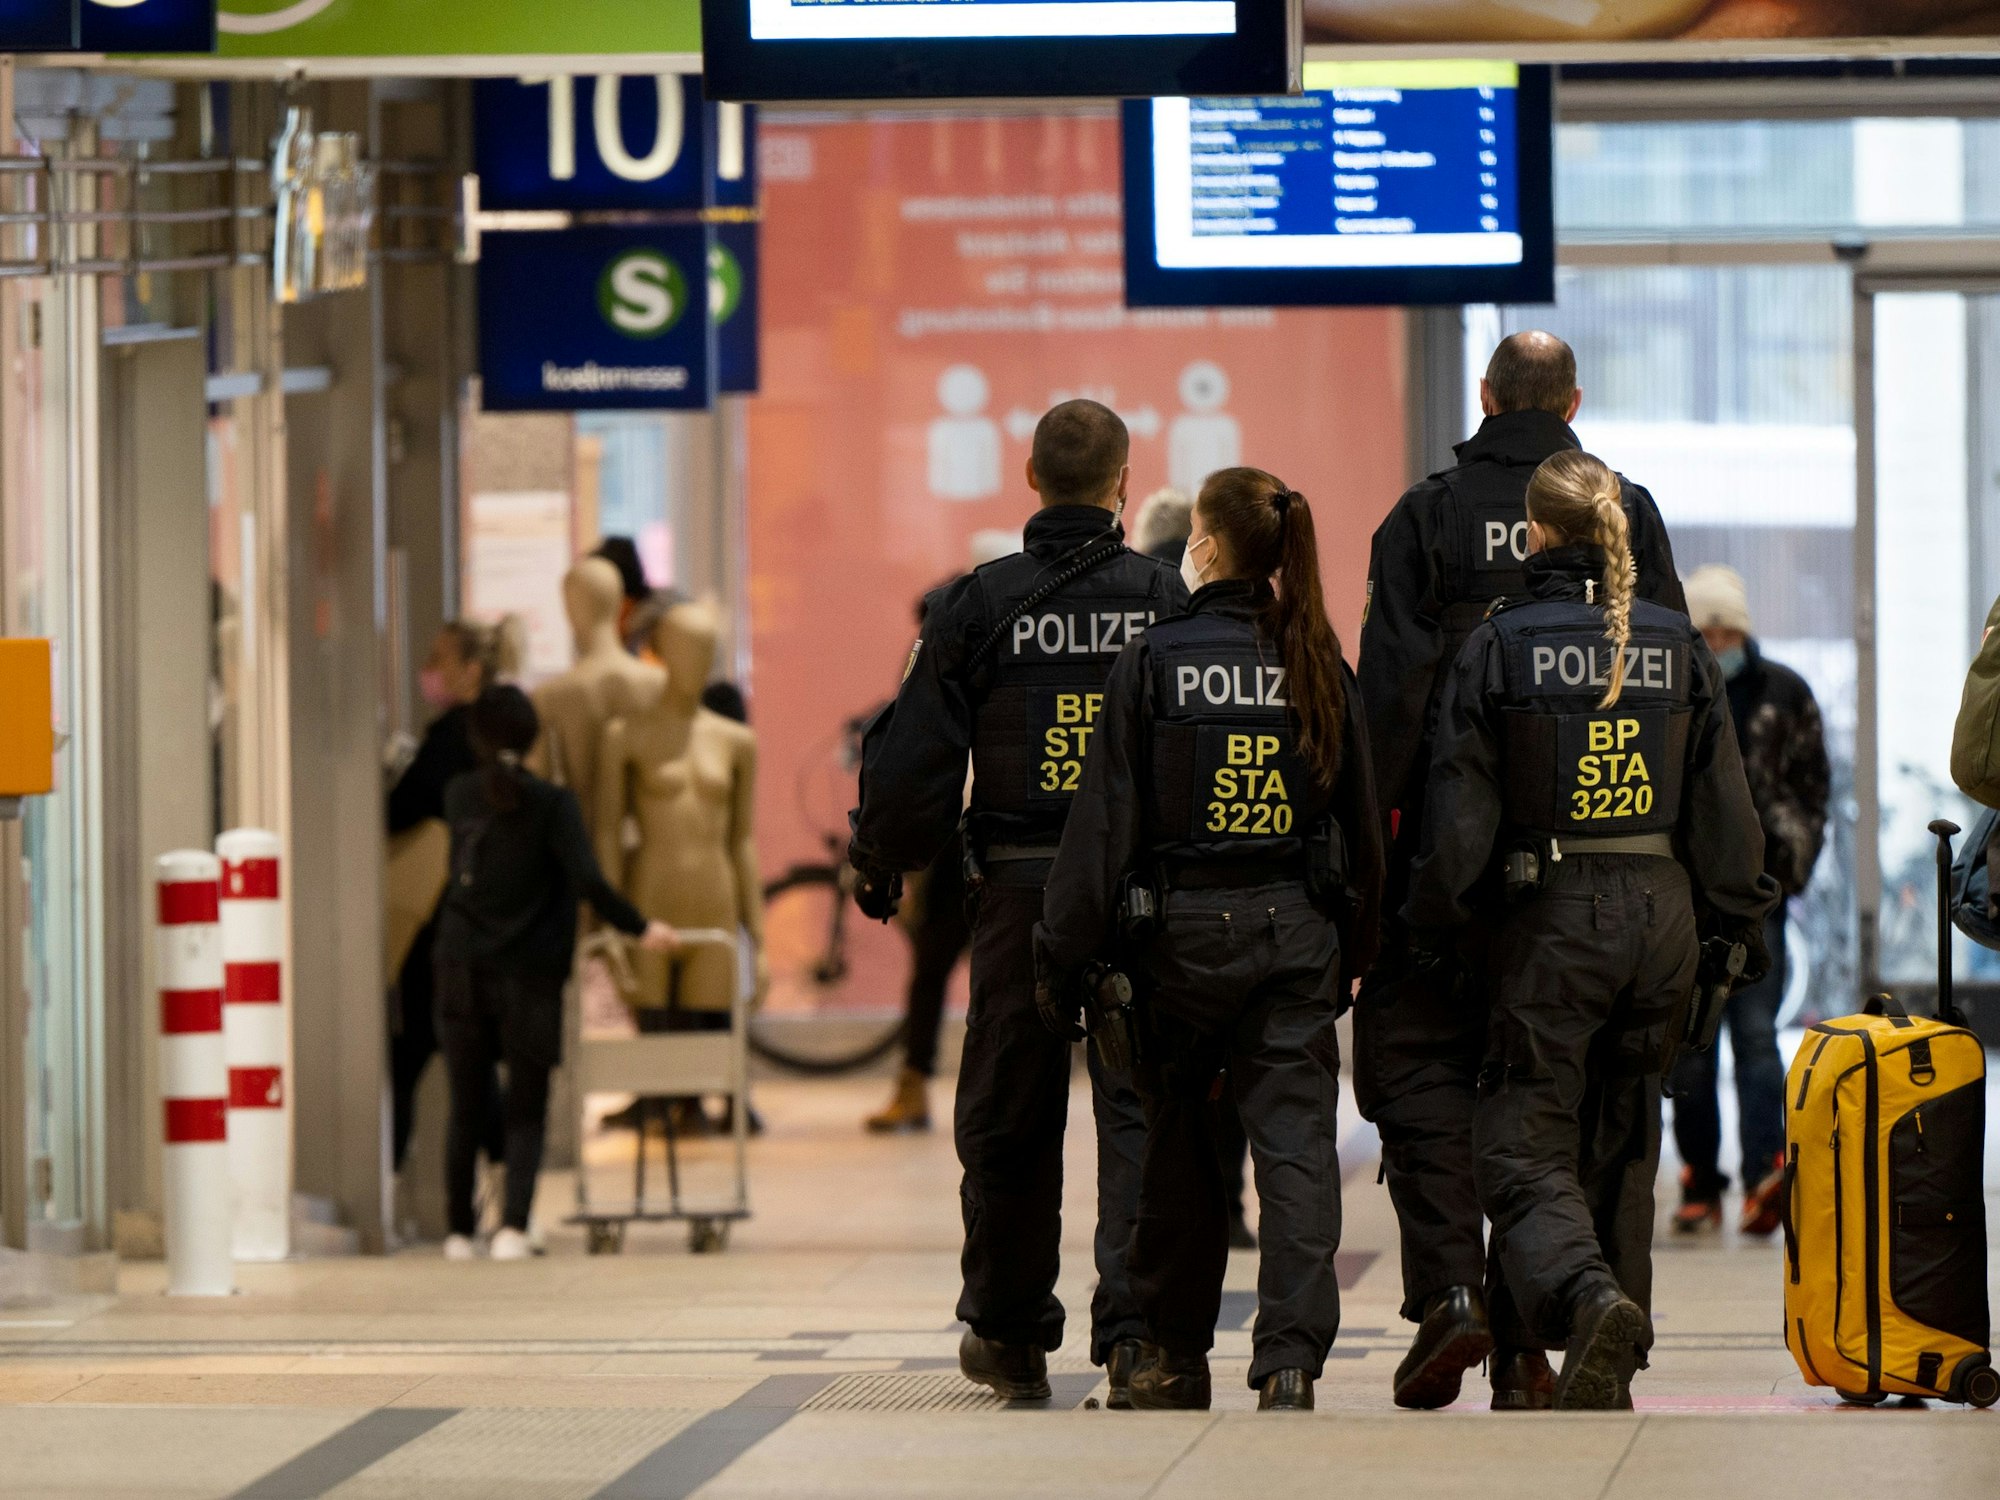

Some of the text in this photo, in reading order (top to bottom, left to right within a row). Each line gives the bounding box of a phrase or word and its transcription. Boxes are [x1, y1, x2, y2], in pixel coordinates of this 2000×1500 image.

[519, 74, 685, 181] 10
[611, 255, 673, 331] S
[1177, 664, 1293, 707] POLIZ
[1056, 693, 1104, 723] BP
[1227, 734, 1280, 766] BP
[1588, 718, 1641, 752] BP
[1213, 767, 1288, 800] STA
[1577, 752, 1650, 787] STA
[1206, 801, 1293, 835] 3220
[1570, 784, 1654, 821] 3220
